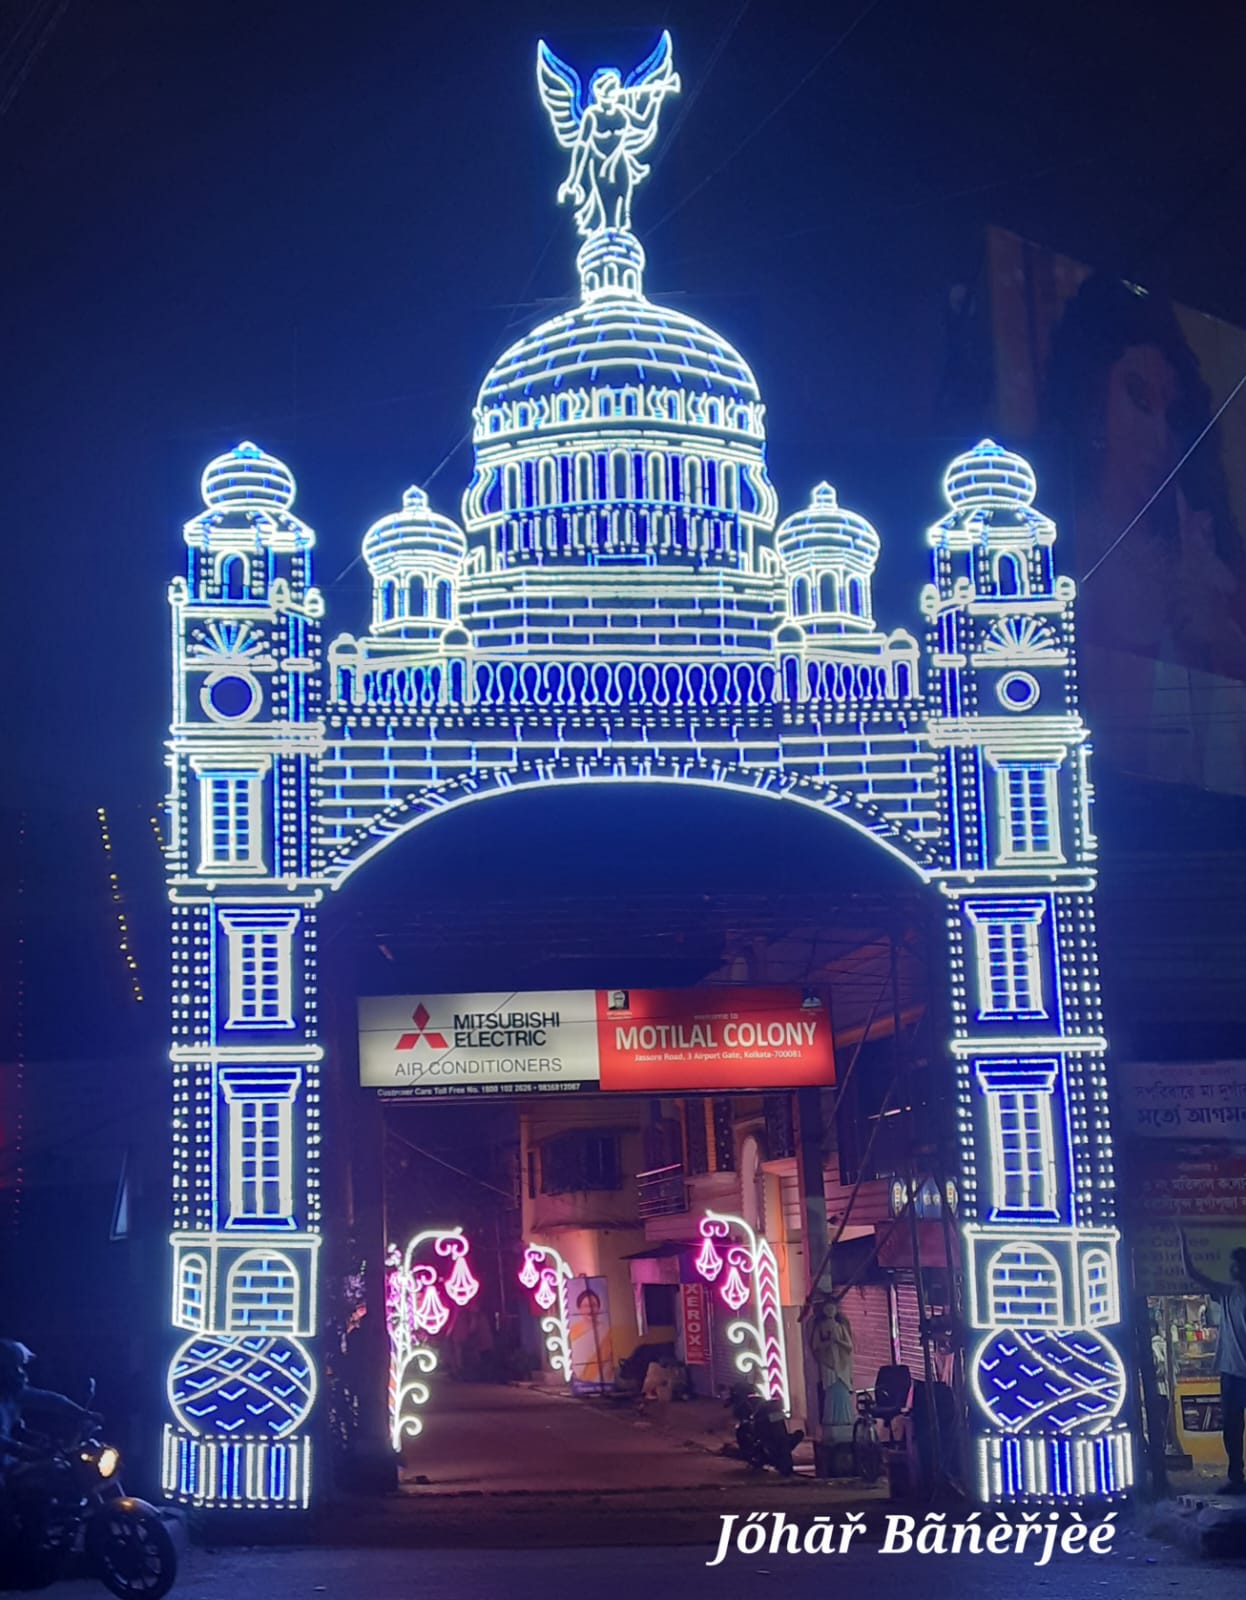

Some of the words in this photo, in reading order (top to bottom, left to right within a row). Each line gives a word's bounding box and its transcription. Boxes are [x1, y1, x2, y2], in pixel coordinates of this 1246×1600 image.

[453, 1011, 560, 1030] MITSUBISHI
[454, 1030, 547, 1048] ELECTRIC
[615, 1025, 717, 1050] MOTILAL
[723, 1022, 817, 1047] COLONY
[694, 1052, 720, 1061] Airport
[394, 1061, 423, 1076] AIR
[428, 1058, 563, 1075] CONDITIONERS
[685, 1284, 702, 1346] XEROX
